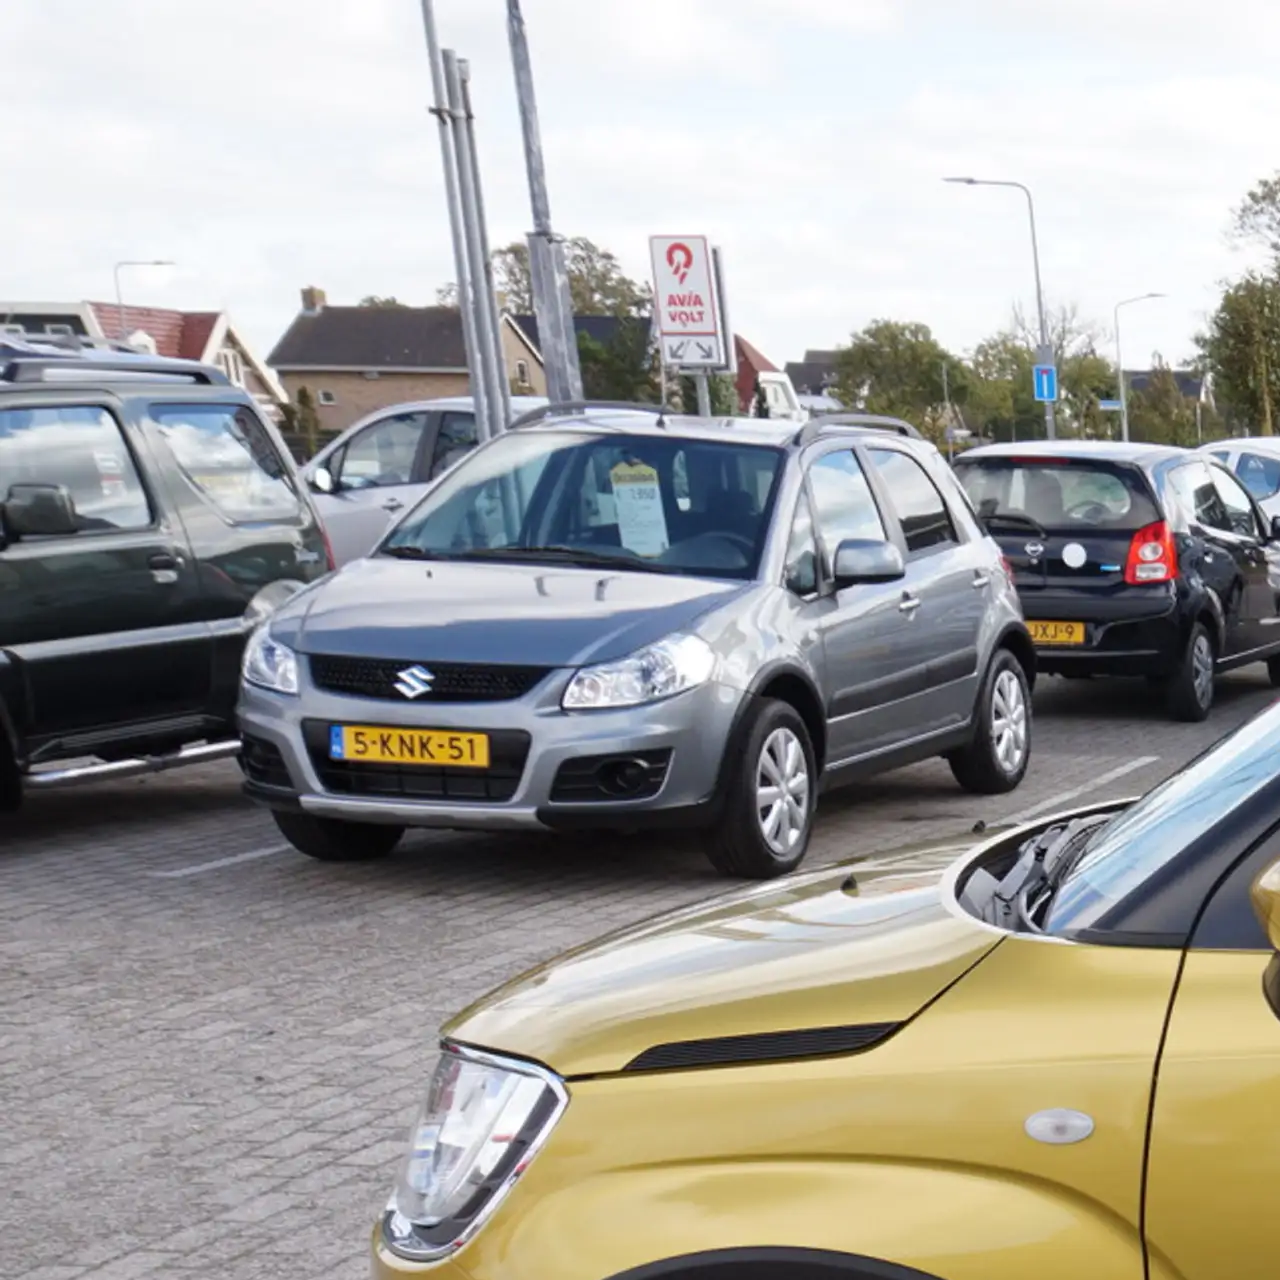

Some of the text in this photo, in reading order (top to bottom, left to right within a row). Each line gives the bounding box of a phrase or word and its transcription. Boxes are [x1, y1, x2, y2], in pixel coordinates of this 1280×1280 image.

[667, 291, 704, 307] AVIA
[668, 311, 705, 327] VOLT
[354, 731, 476, 761] 5-KNK-51
